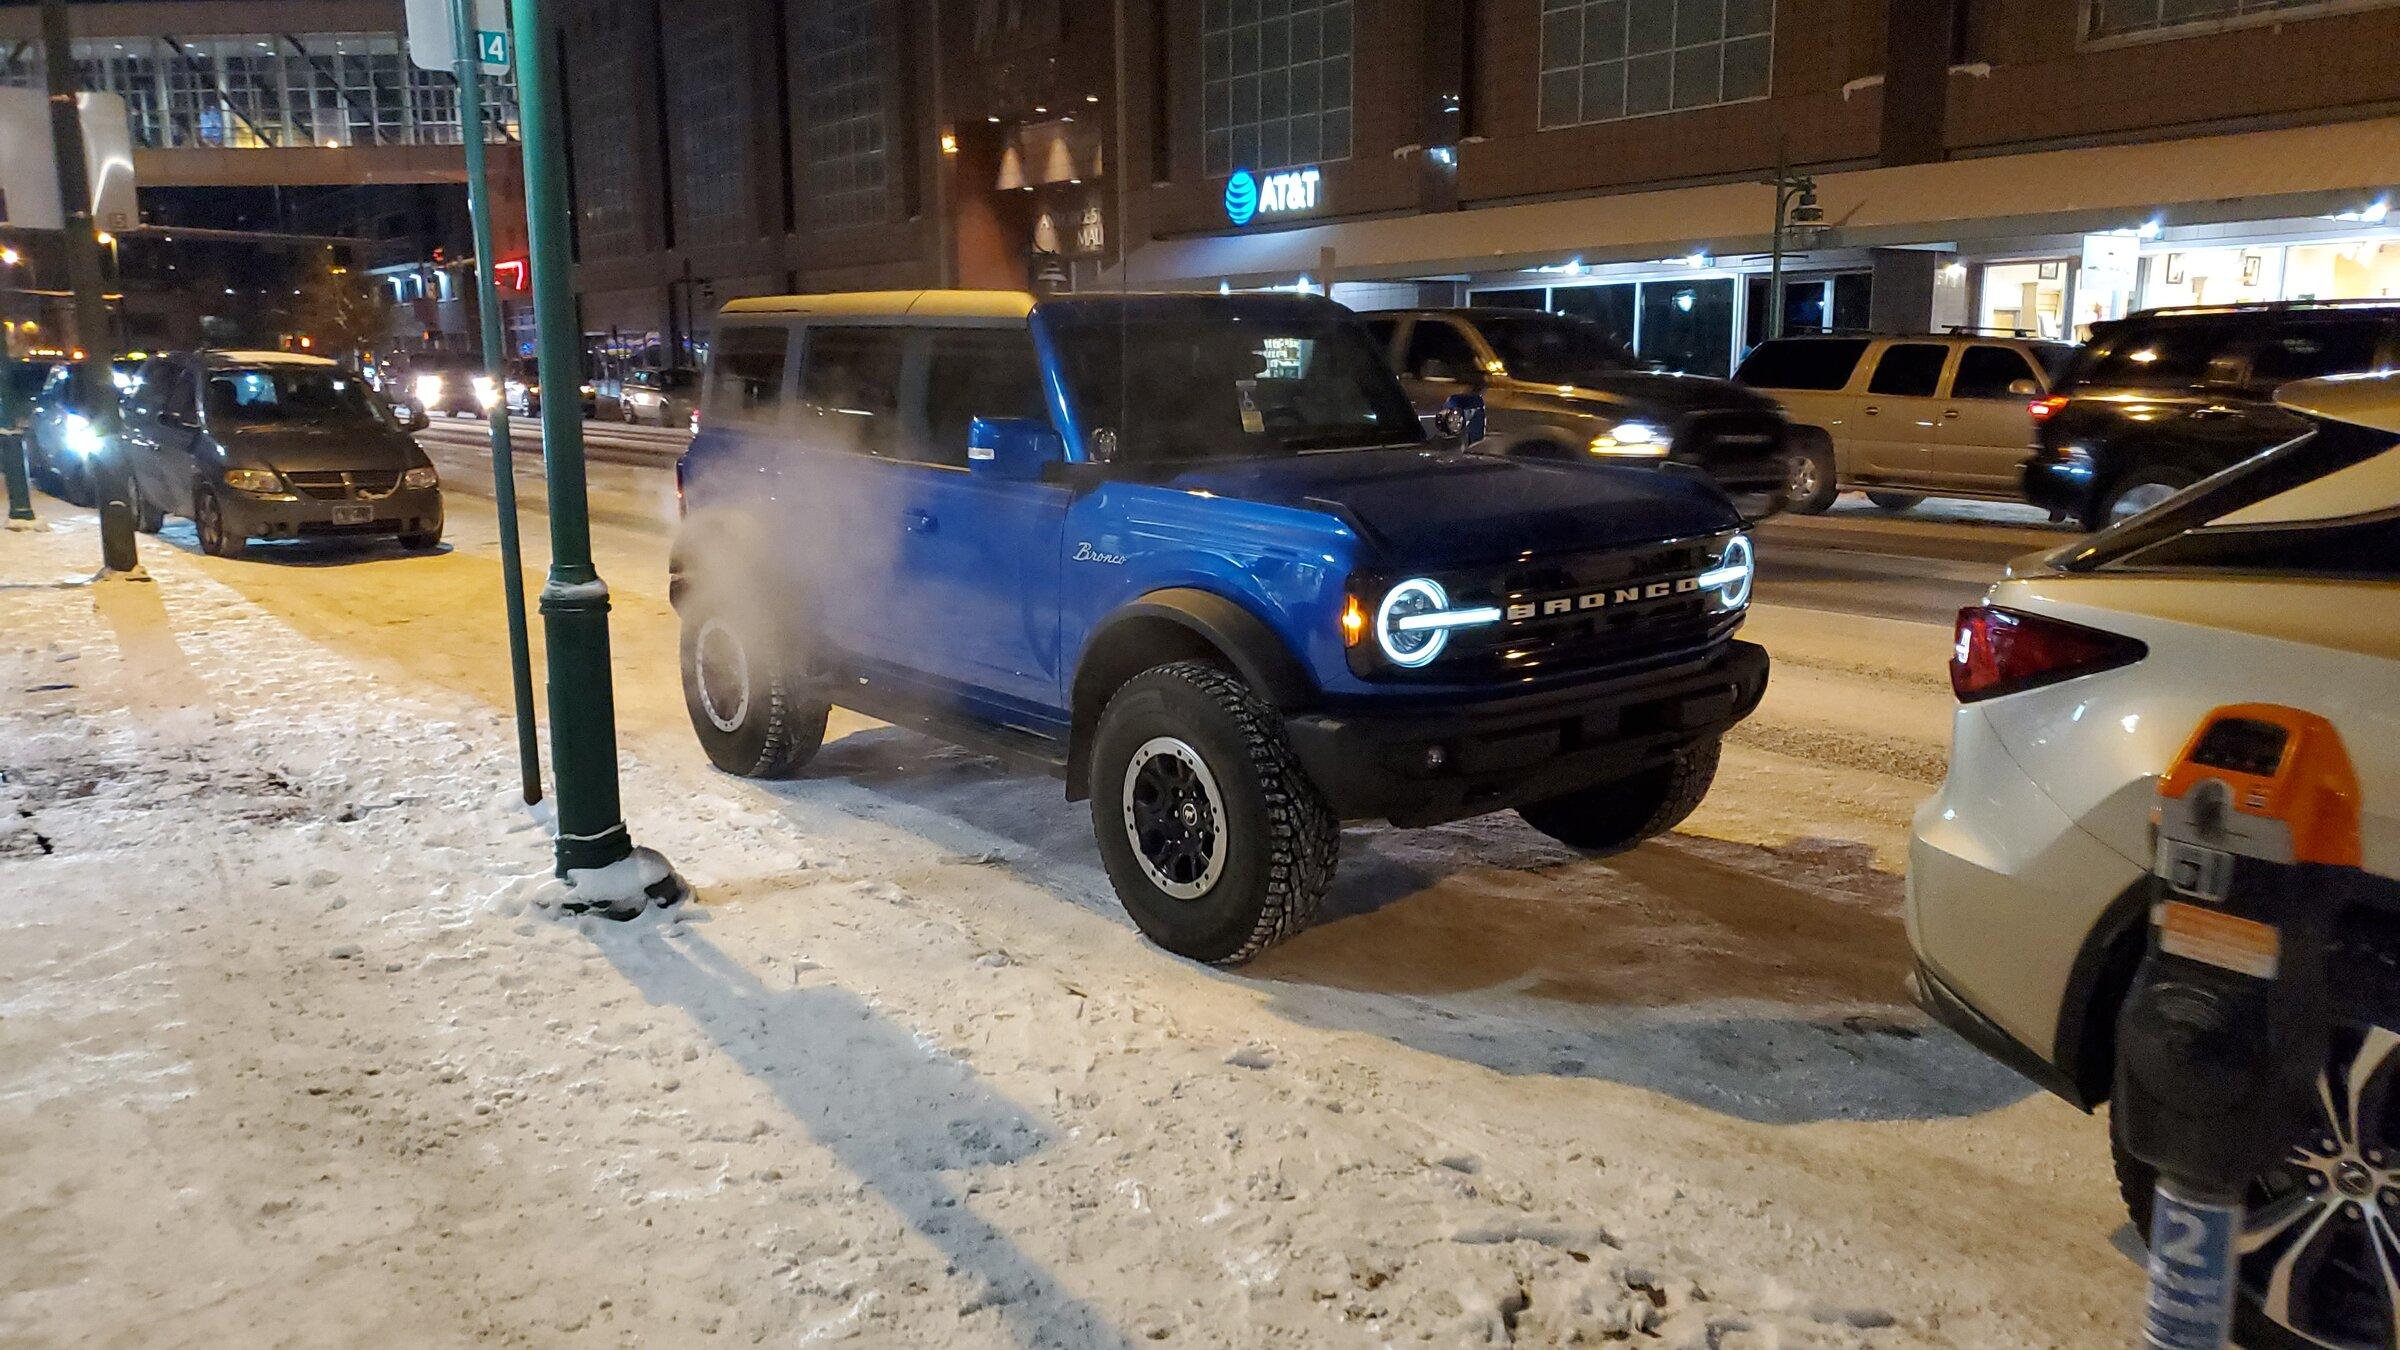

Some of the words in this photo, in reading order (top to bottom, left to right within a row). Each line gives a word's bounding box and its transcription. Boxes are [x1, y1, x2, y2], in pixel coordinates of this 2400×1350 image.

[478, 33, 504, 61] 14
[1259, 170, 1319, 212] AT&T
[1072, 541, 1127, 565] Bronco
[1506, 577, 1699, 621] BRONCO
[2162, 1209, 2207, 1268] 2
